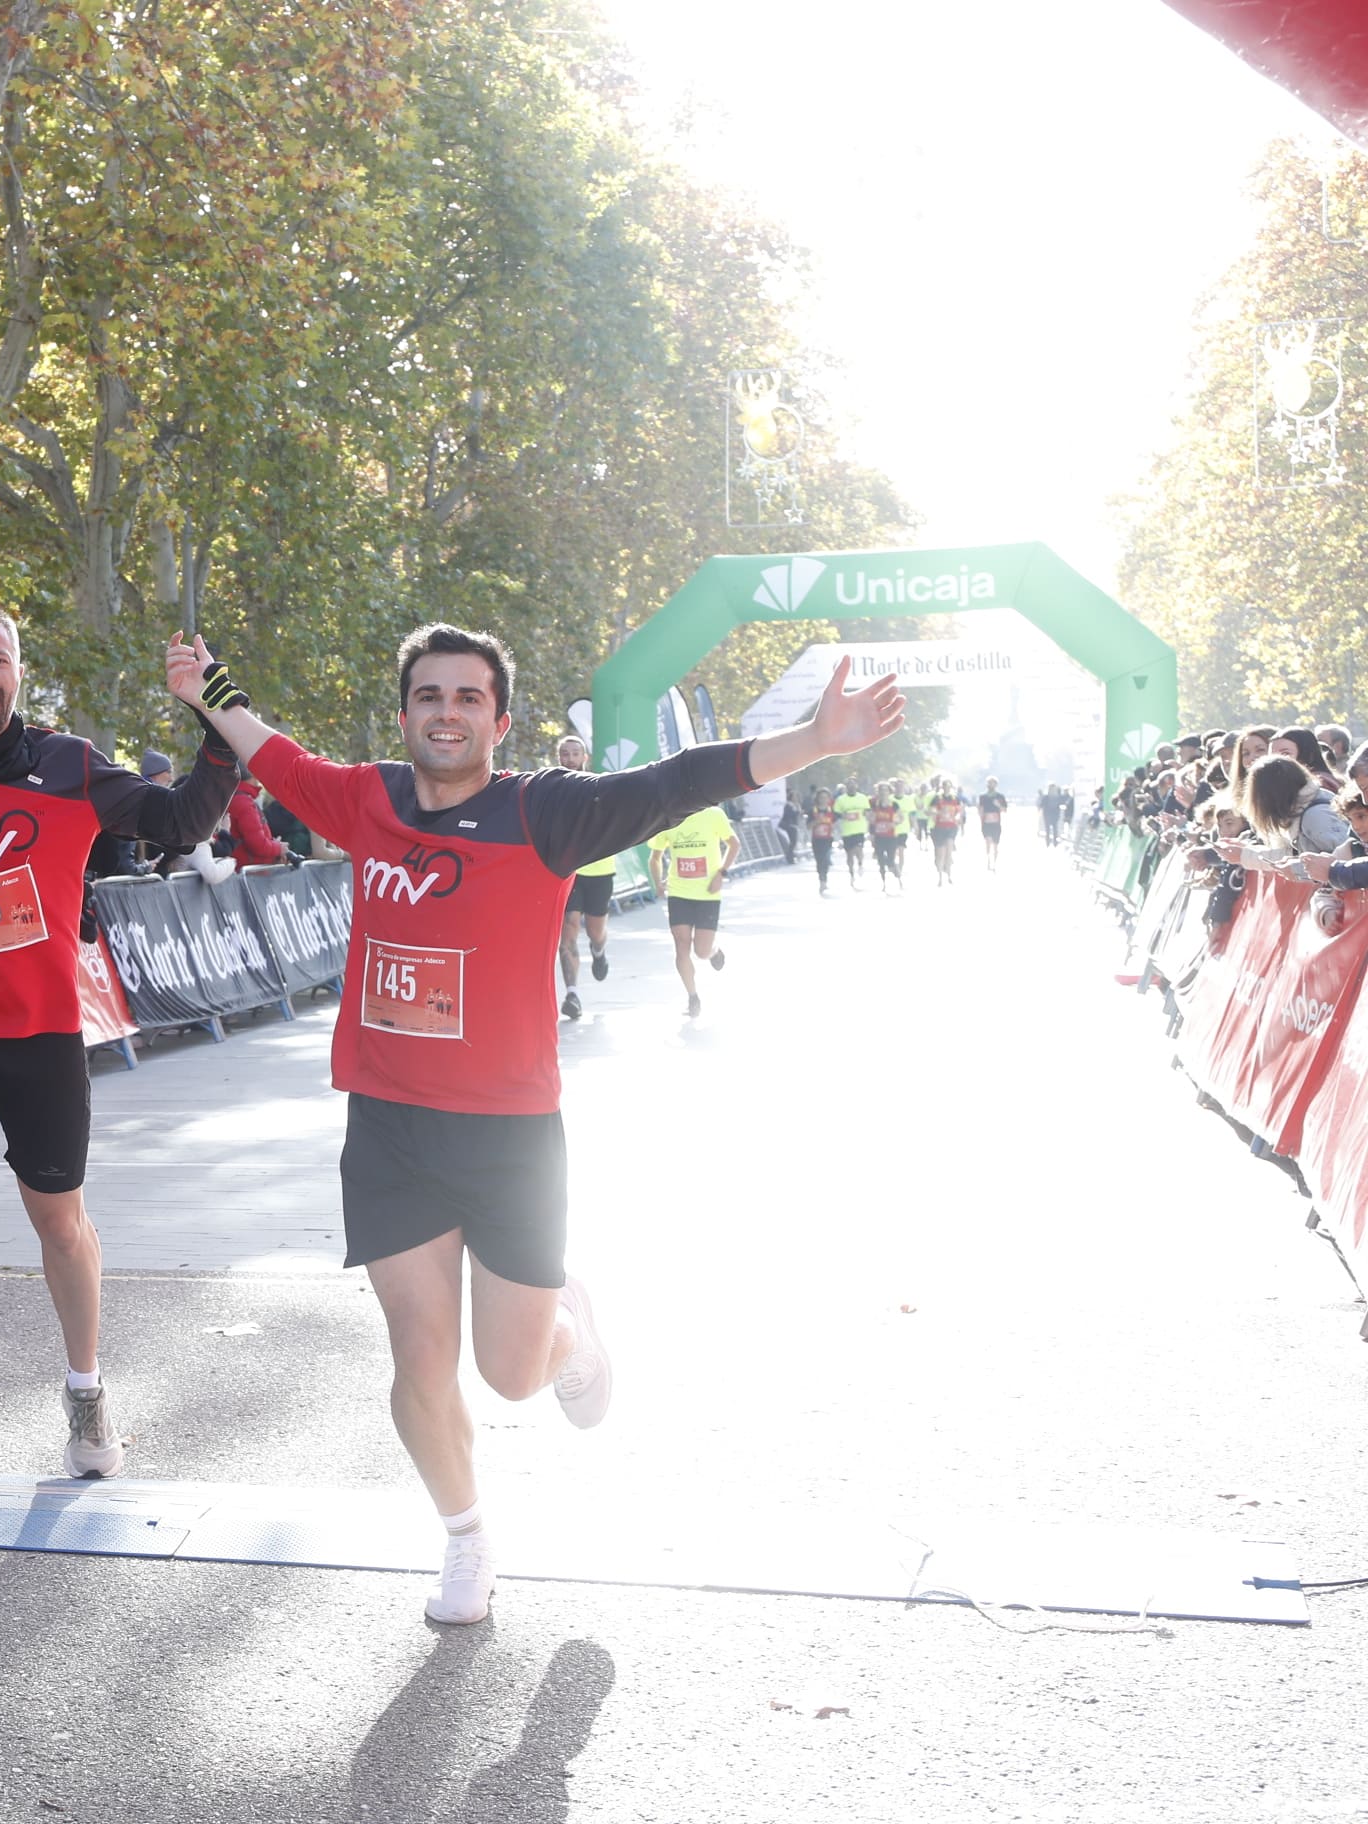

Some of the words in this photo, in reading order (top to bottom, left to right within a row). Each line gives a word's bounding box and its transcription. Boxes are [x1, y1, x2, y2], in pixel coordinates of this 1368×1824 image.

[836, 564, 995, 607] Unicaja
[861, 655, 911, 677] Norte
[914, 656, 932, 674] de
[937, 651, 1012, 674] Castilla
[679, 861, 696, 872] 326
[376, 959, 417, 1002] 145
